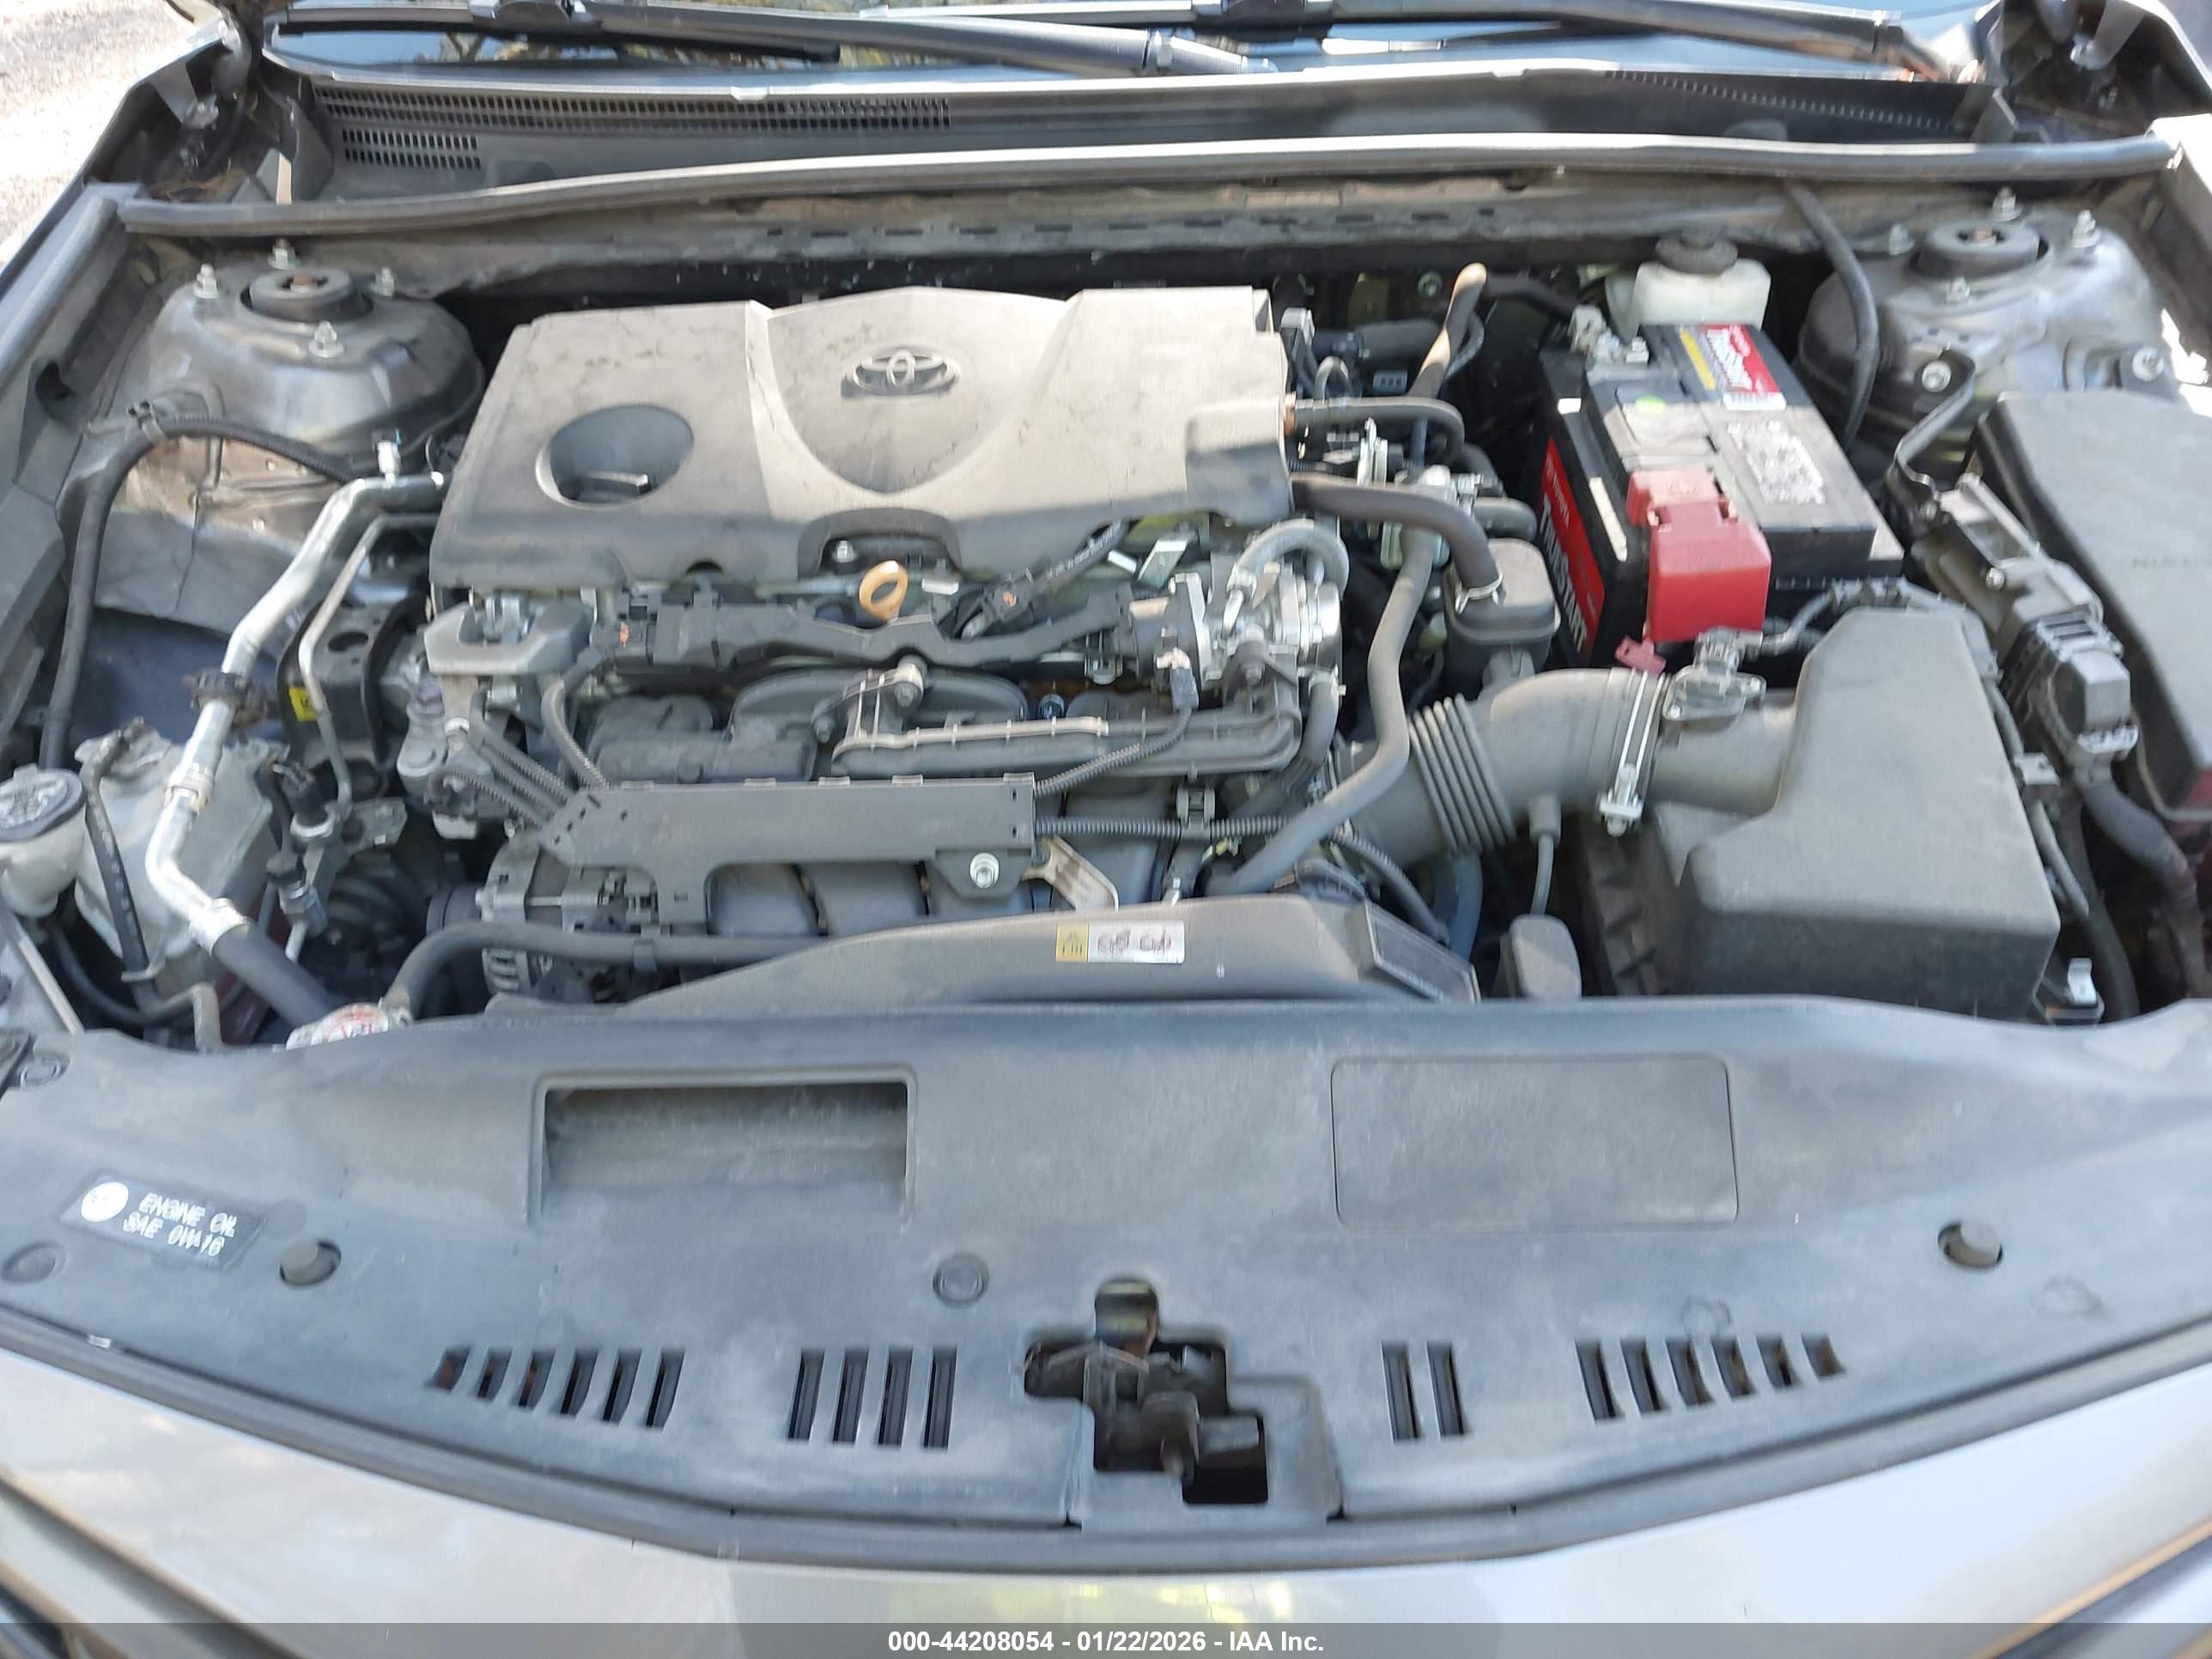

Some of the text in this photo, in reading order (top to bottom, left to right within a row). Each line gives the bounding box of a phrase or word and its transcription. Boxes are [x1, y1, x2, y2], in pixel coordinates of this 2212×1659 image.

[122, 1211, 164, 1239] SAE
[138, 1192, 206, 1227] ENGINE
[210, 1212, 237, 1237] OIL
